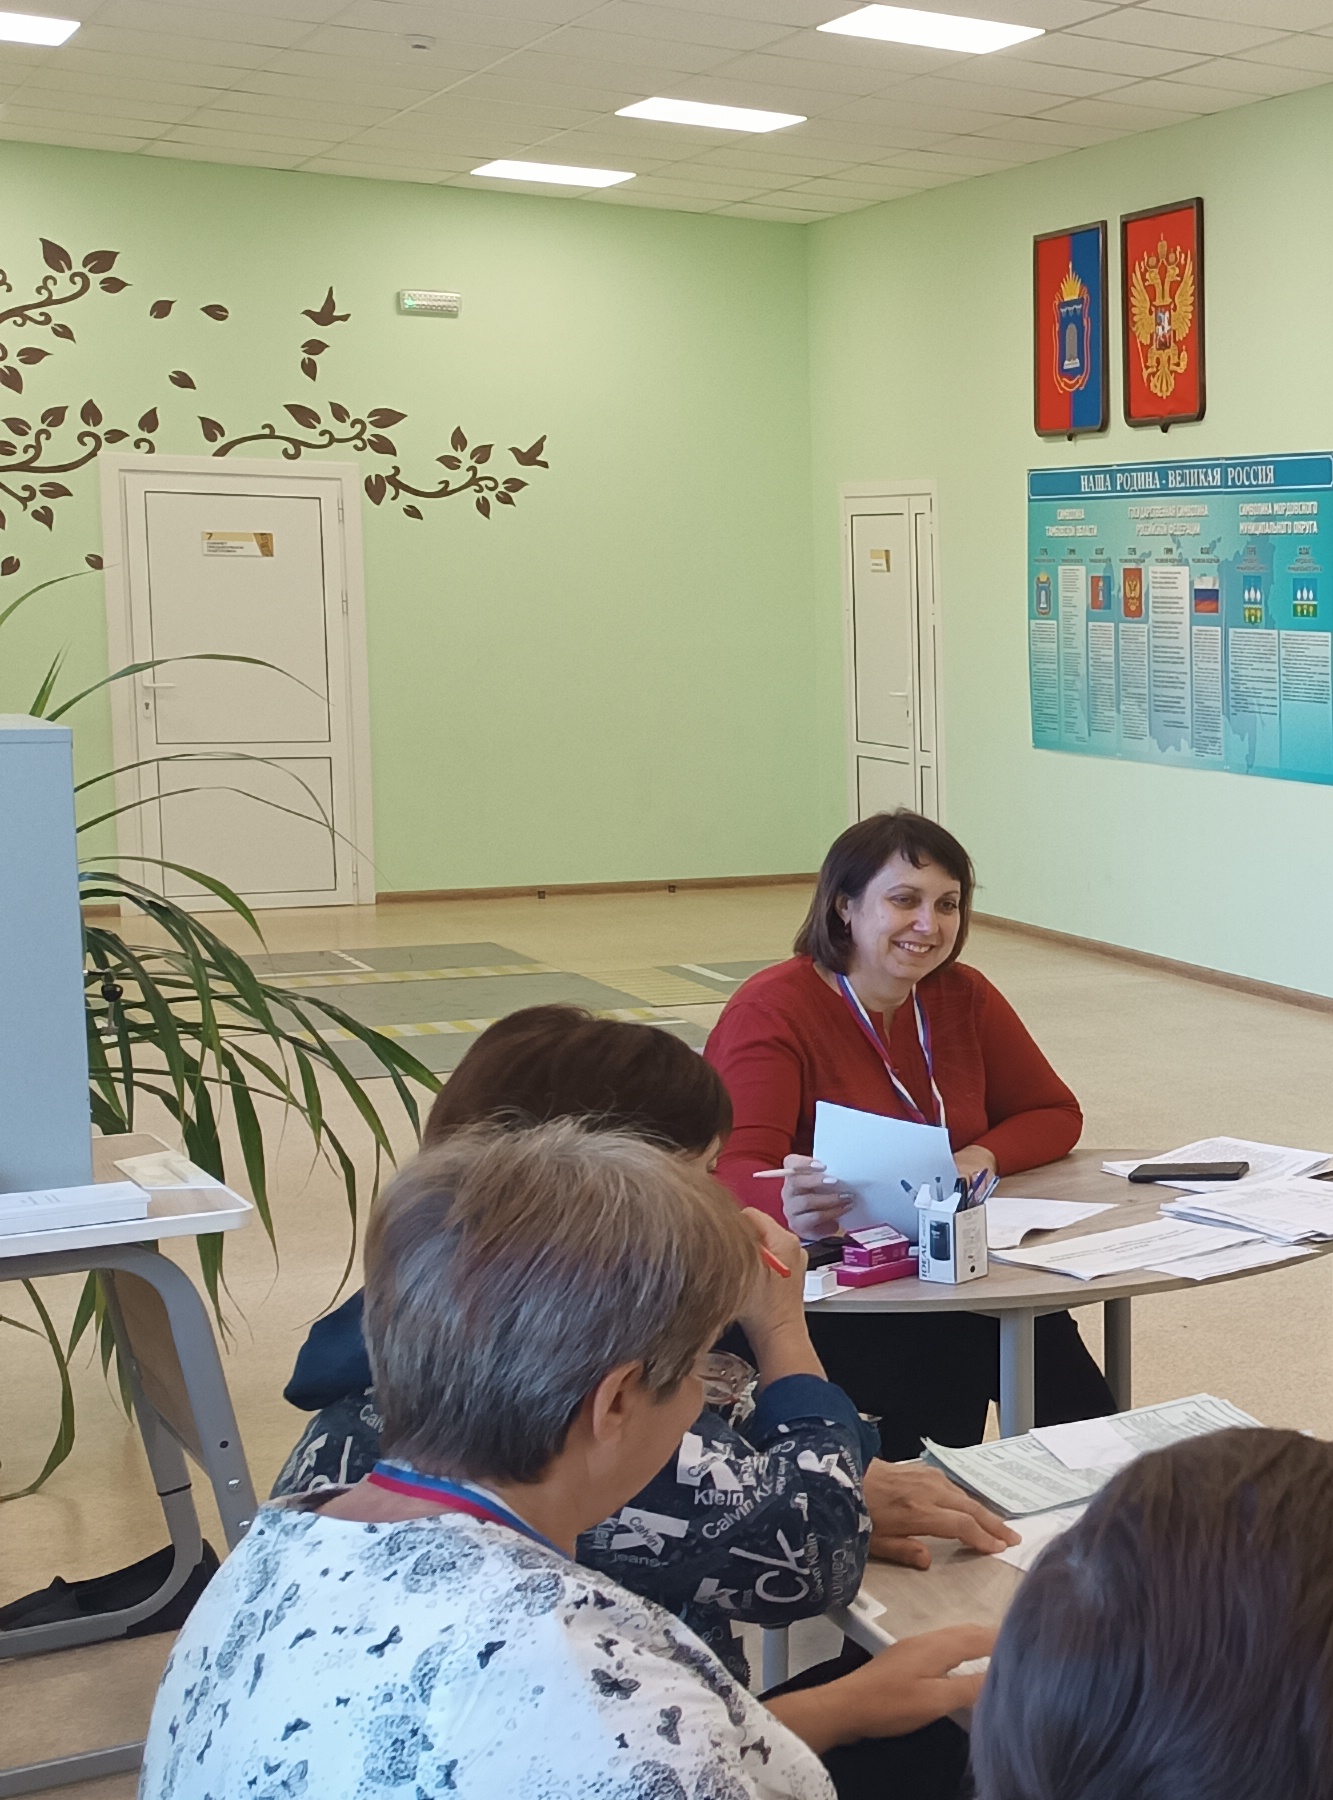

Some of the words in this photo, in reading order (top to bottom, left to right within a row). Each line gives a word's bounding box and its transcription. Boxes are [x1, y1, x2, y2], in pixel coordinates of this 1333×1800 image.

[1080, 473, 1112, 492] НАША
[1116, 471, 1160, 492] РОДИНА
[1167, 467, 1221, 488] ВЕЛИКАЯ
[1227, 465, 1275, 486] РОССИЯ
